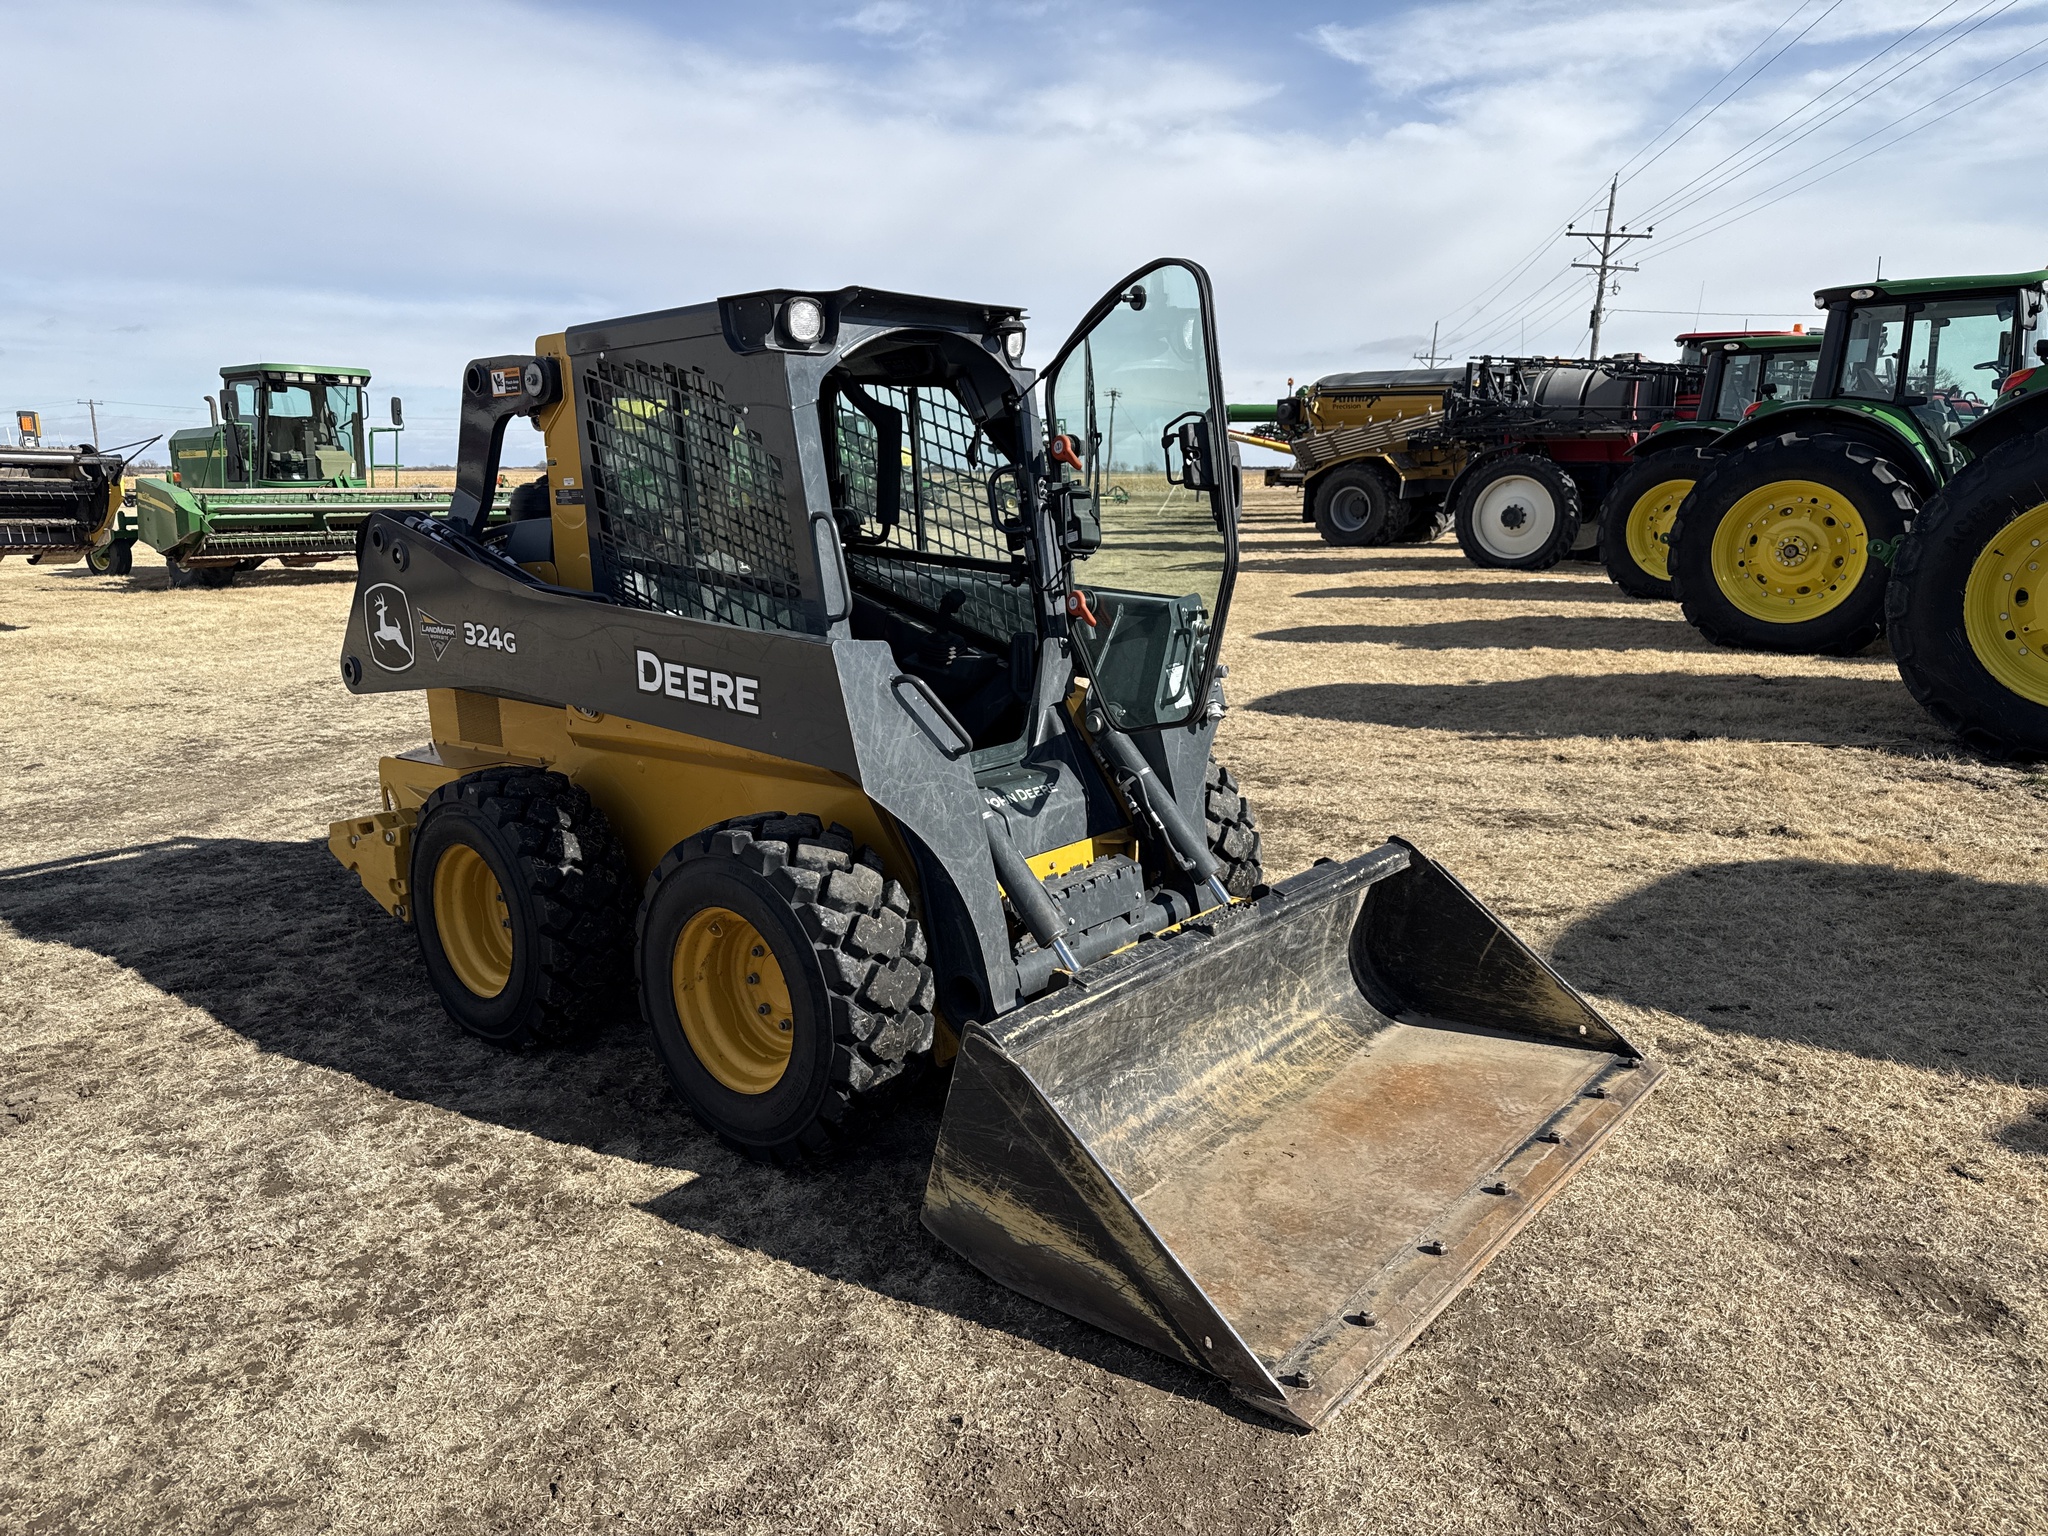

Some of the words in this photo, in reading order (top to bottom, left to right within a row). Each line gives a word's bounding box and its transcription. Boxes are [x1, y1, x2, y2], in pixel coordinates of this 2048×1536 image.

[463, 622, 517, 654] 324G
[636, 649, 760, 715] DEERE
[1015, 782, 1059, 801] DEERE
